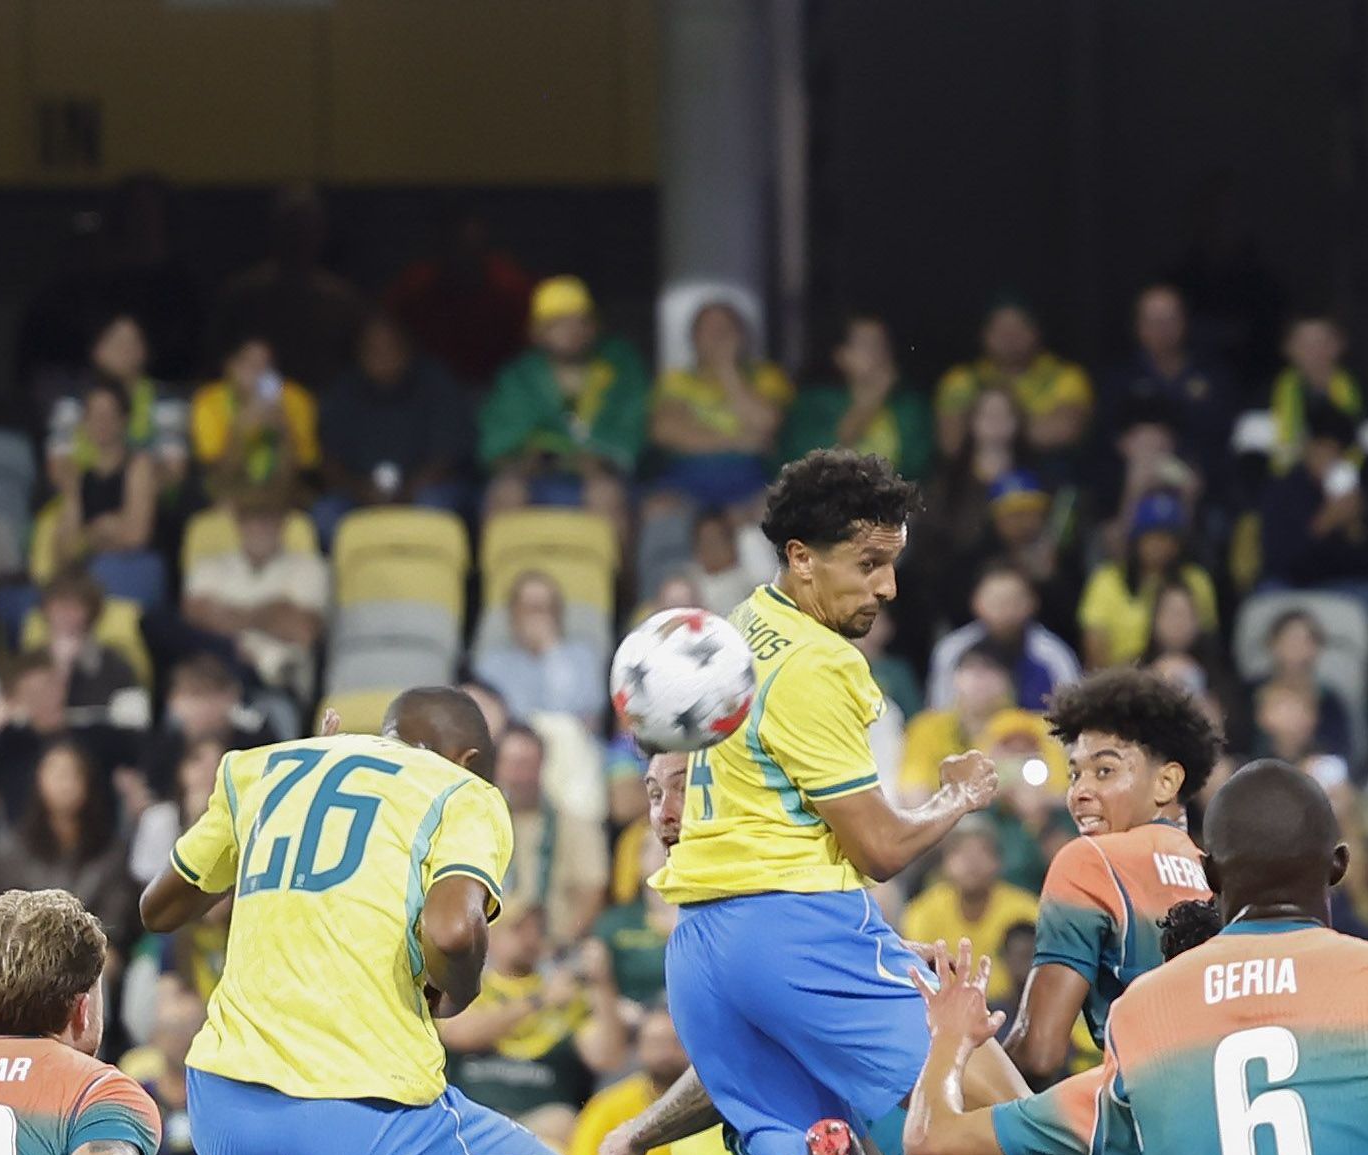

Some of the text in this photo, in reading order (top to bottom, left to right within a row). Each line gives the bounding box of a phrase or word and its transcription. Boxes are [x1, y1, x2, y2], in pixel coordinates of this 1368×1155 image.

[38, 100, 101, 168] IN
[238, 748, 404, 898] 26
[1204, 957, 1297, 1005] GERIA
